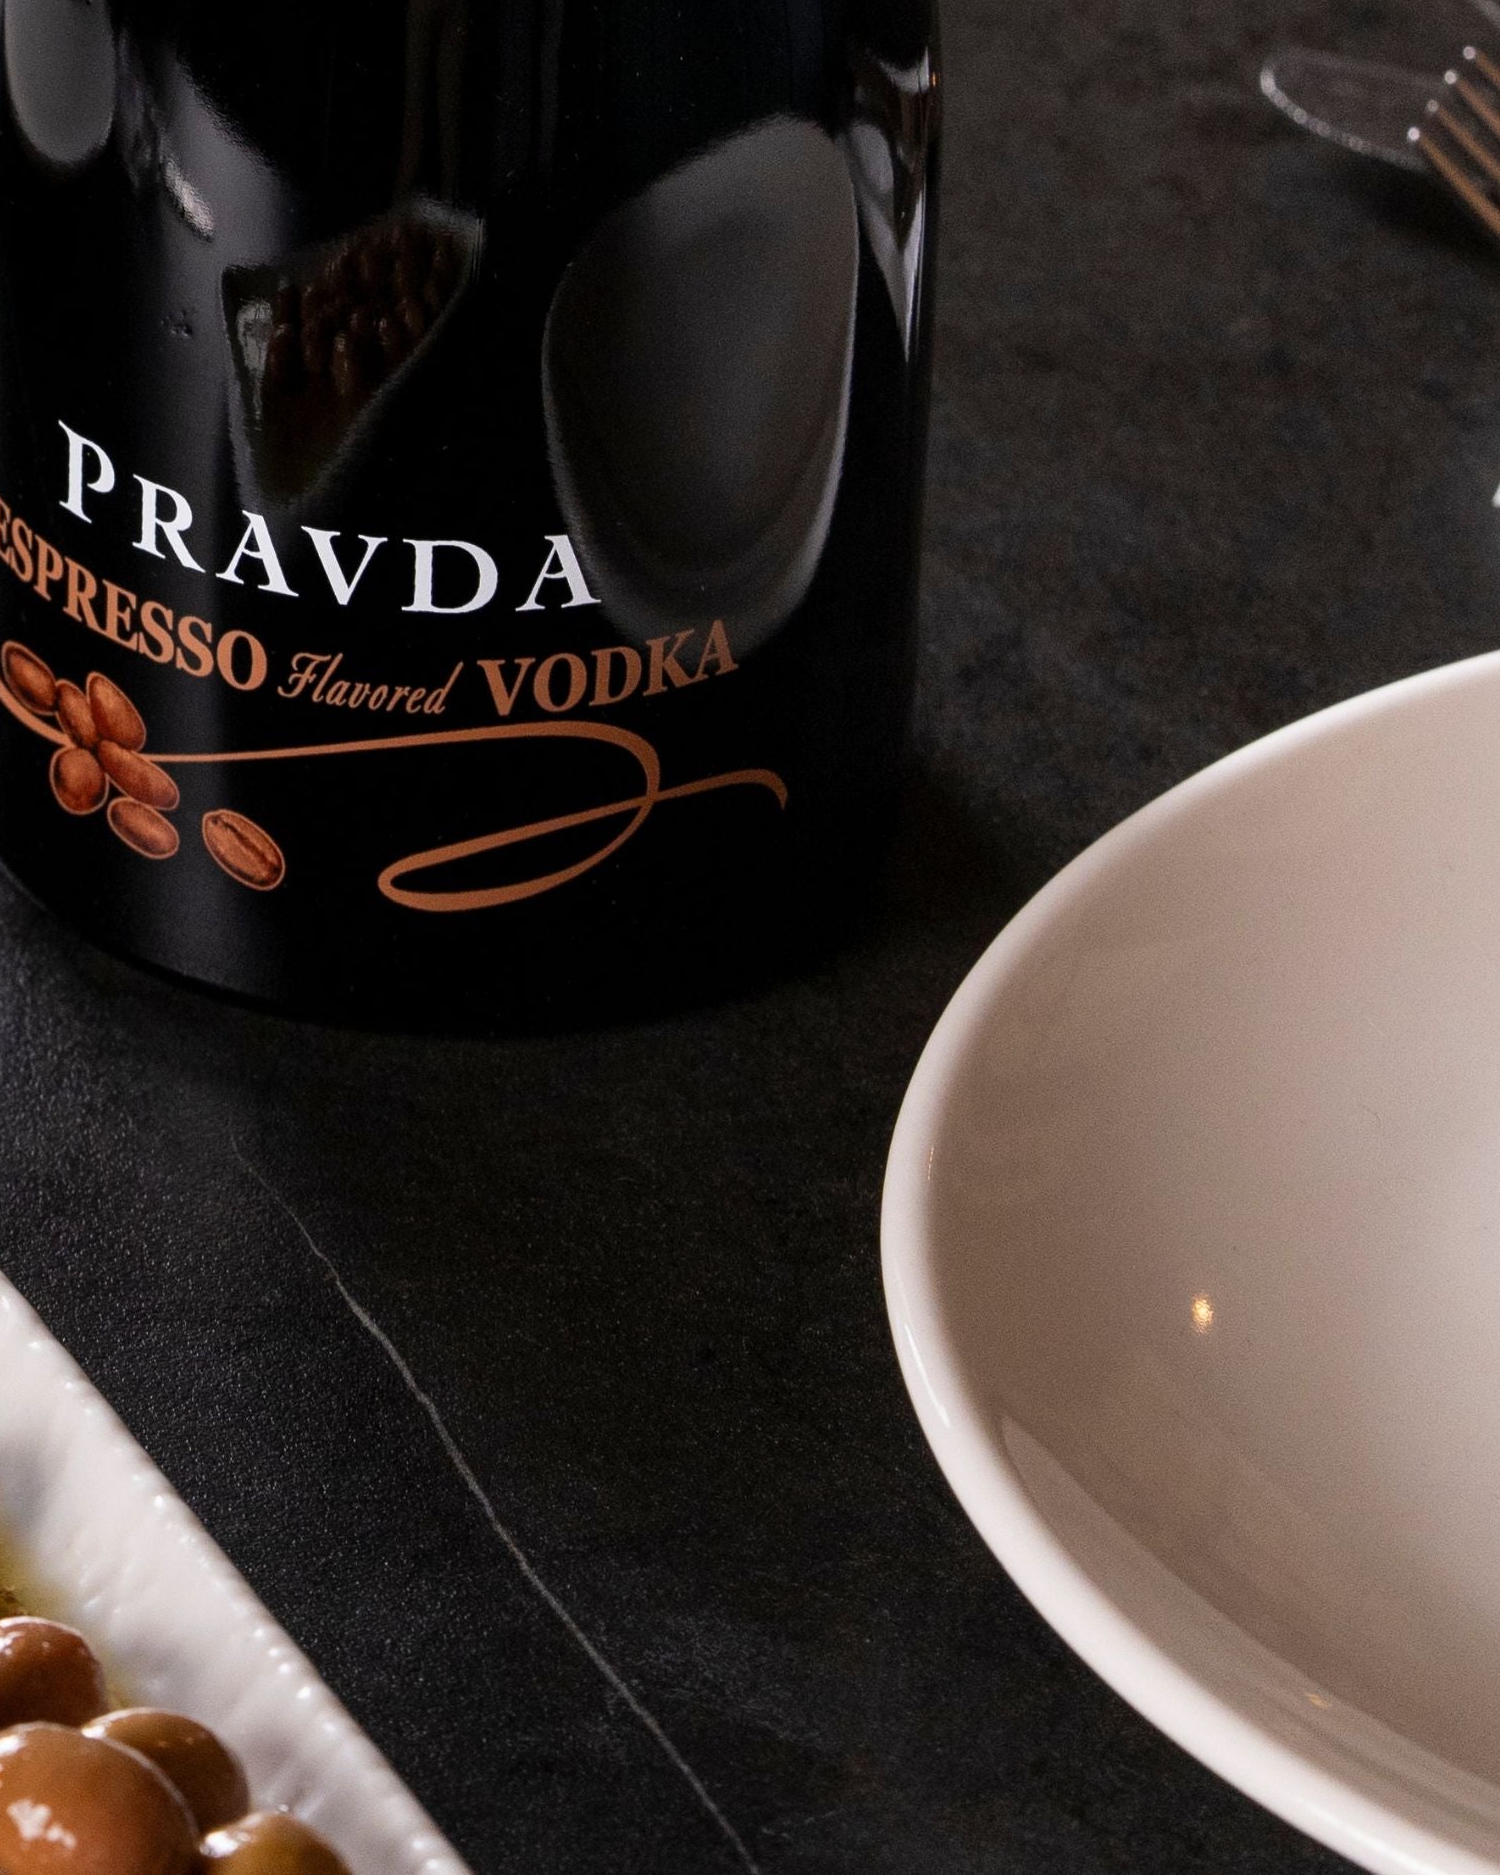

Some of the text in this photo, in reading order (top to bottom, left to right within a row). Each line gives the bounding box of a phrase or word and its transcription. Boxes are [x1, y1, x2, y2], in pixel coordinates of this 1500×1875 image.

[58, 420, 602, 614] PRAVDA
[276, 651, 464, 715] Flavored
[477, 619, 737, 717] VODKA
